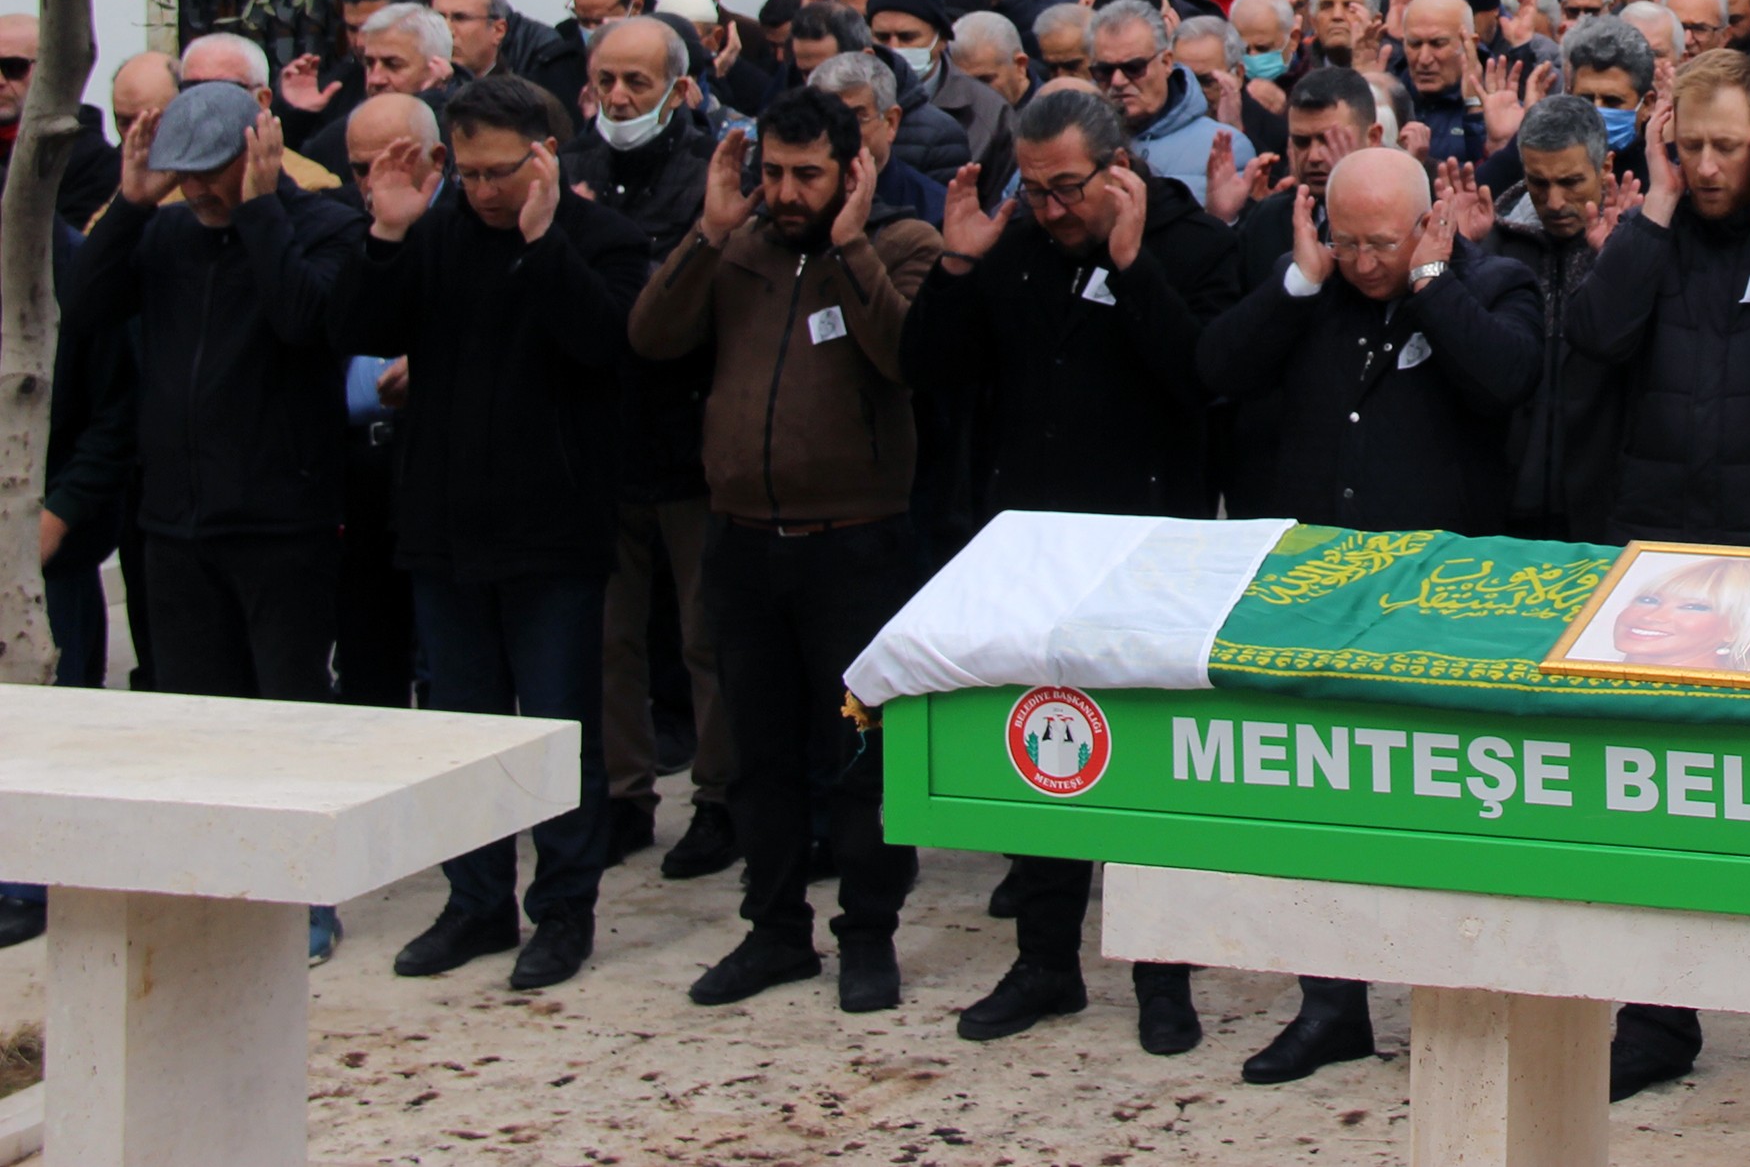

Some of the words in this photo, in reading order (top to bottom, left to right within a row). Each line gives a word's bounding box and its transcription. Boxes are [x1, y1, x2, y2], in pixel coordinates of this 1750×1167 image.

[1014, 691, 1051, 728] BELEDİYE
[1053, 691, 1103, 734] BAŞKANLIĞI
[1034, 772, 1084, 790] MENTEŞE
[1172, 716, 1573, 818] MENTEŞE
